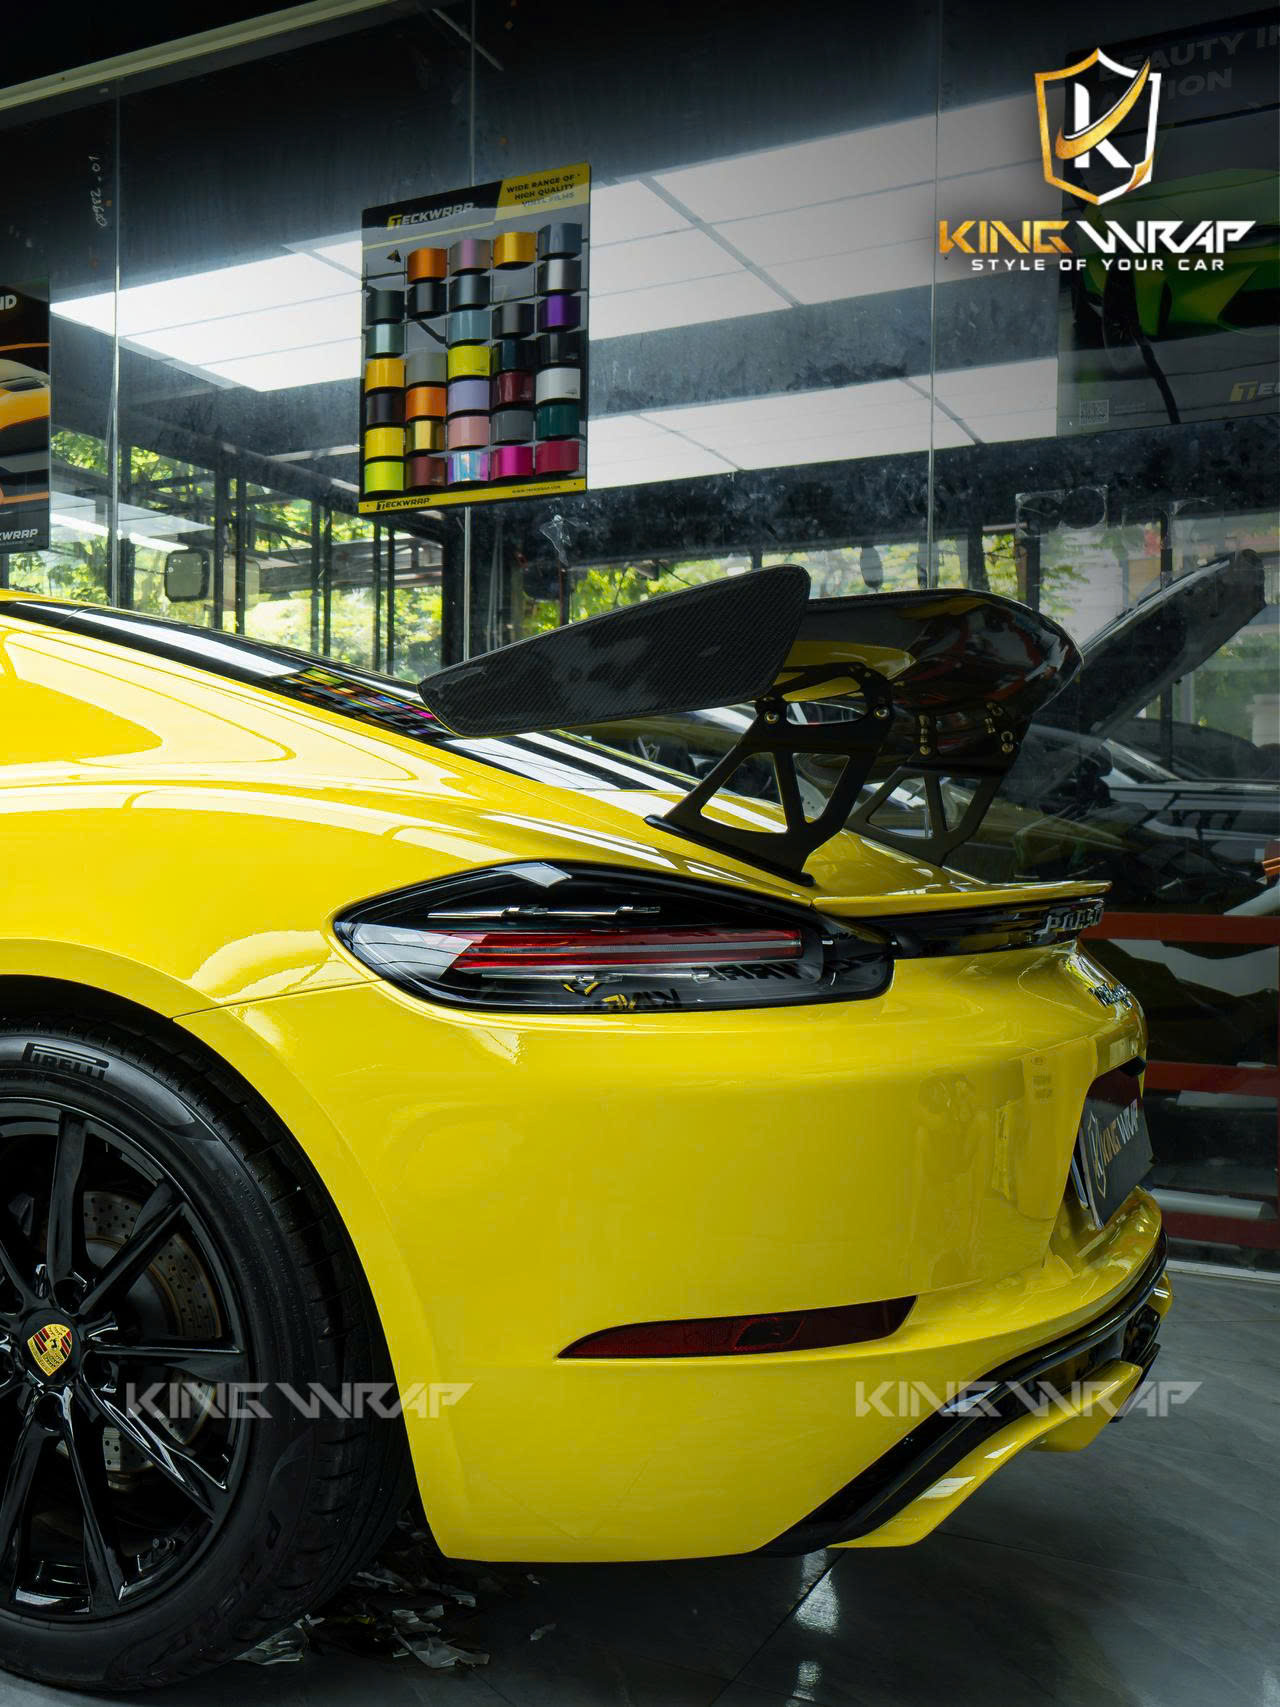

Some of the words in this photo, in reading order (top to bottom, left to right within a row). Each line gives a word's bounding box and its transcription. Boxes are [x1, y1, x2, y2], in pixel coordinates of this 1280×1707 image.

[506, 183, 529, 193] WIDE
[531, 177, 561, 188] RANGE
[563, 174, 575, 182] OF
[514, 190, 535, 200] HIGH
[537, 183, 575, 196] QUALITY
[376, 497, 431, 511] TECKWRAP
[21, 1042, 110, 1081] PIRELLI
